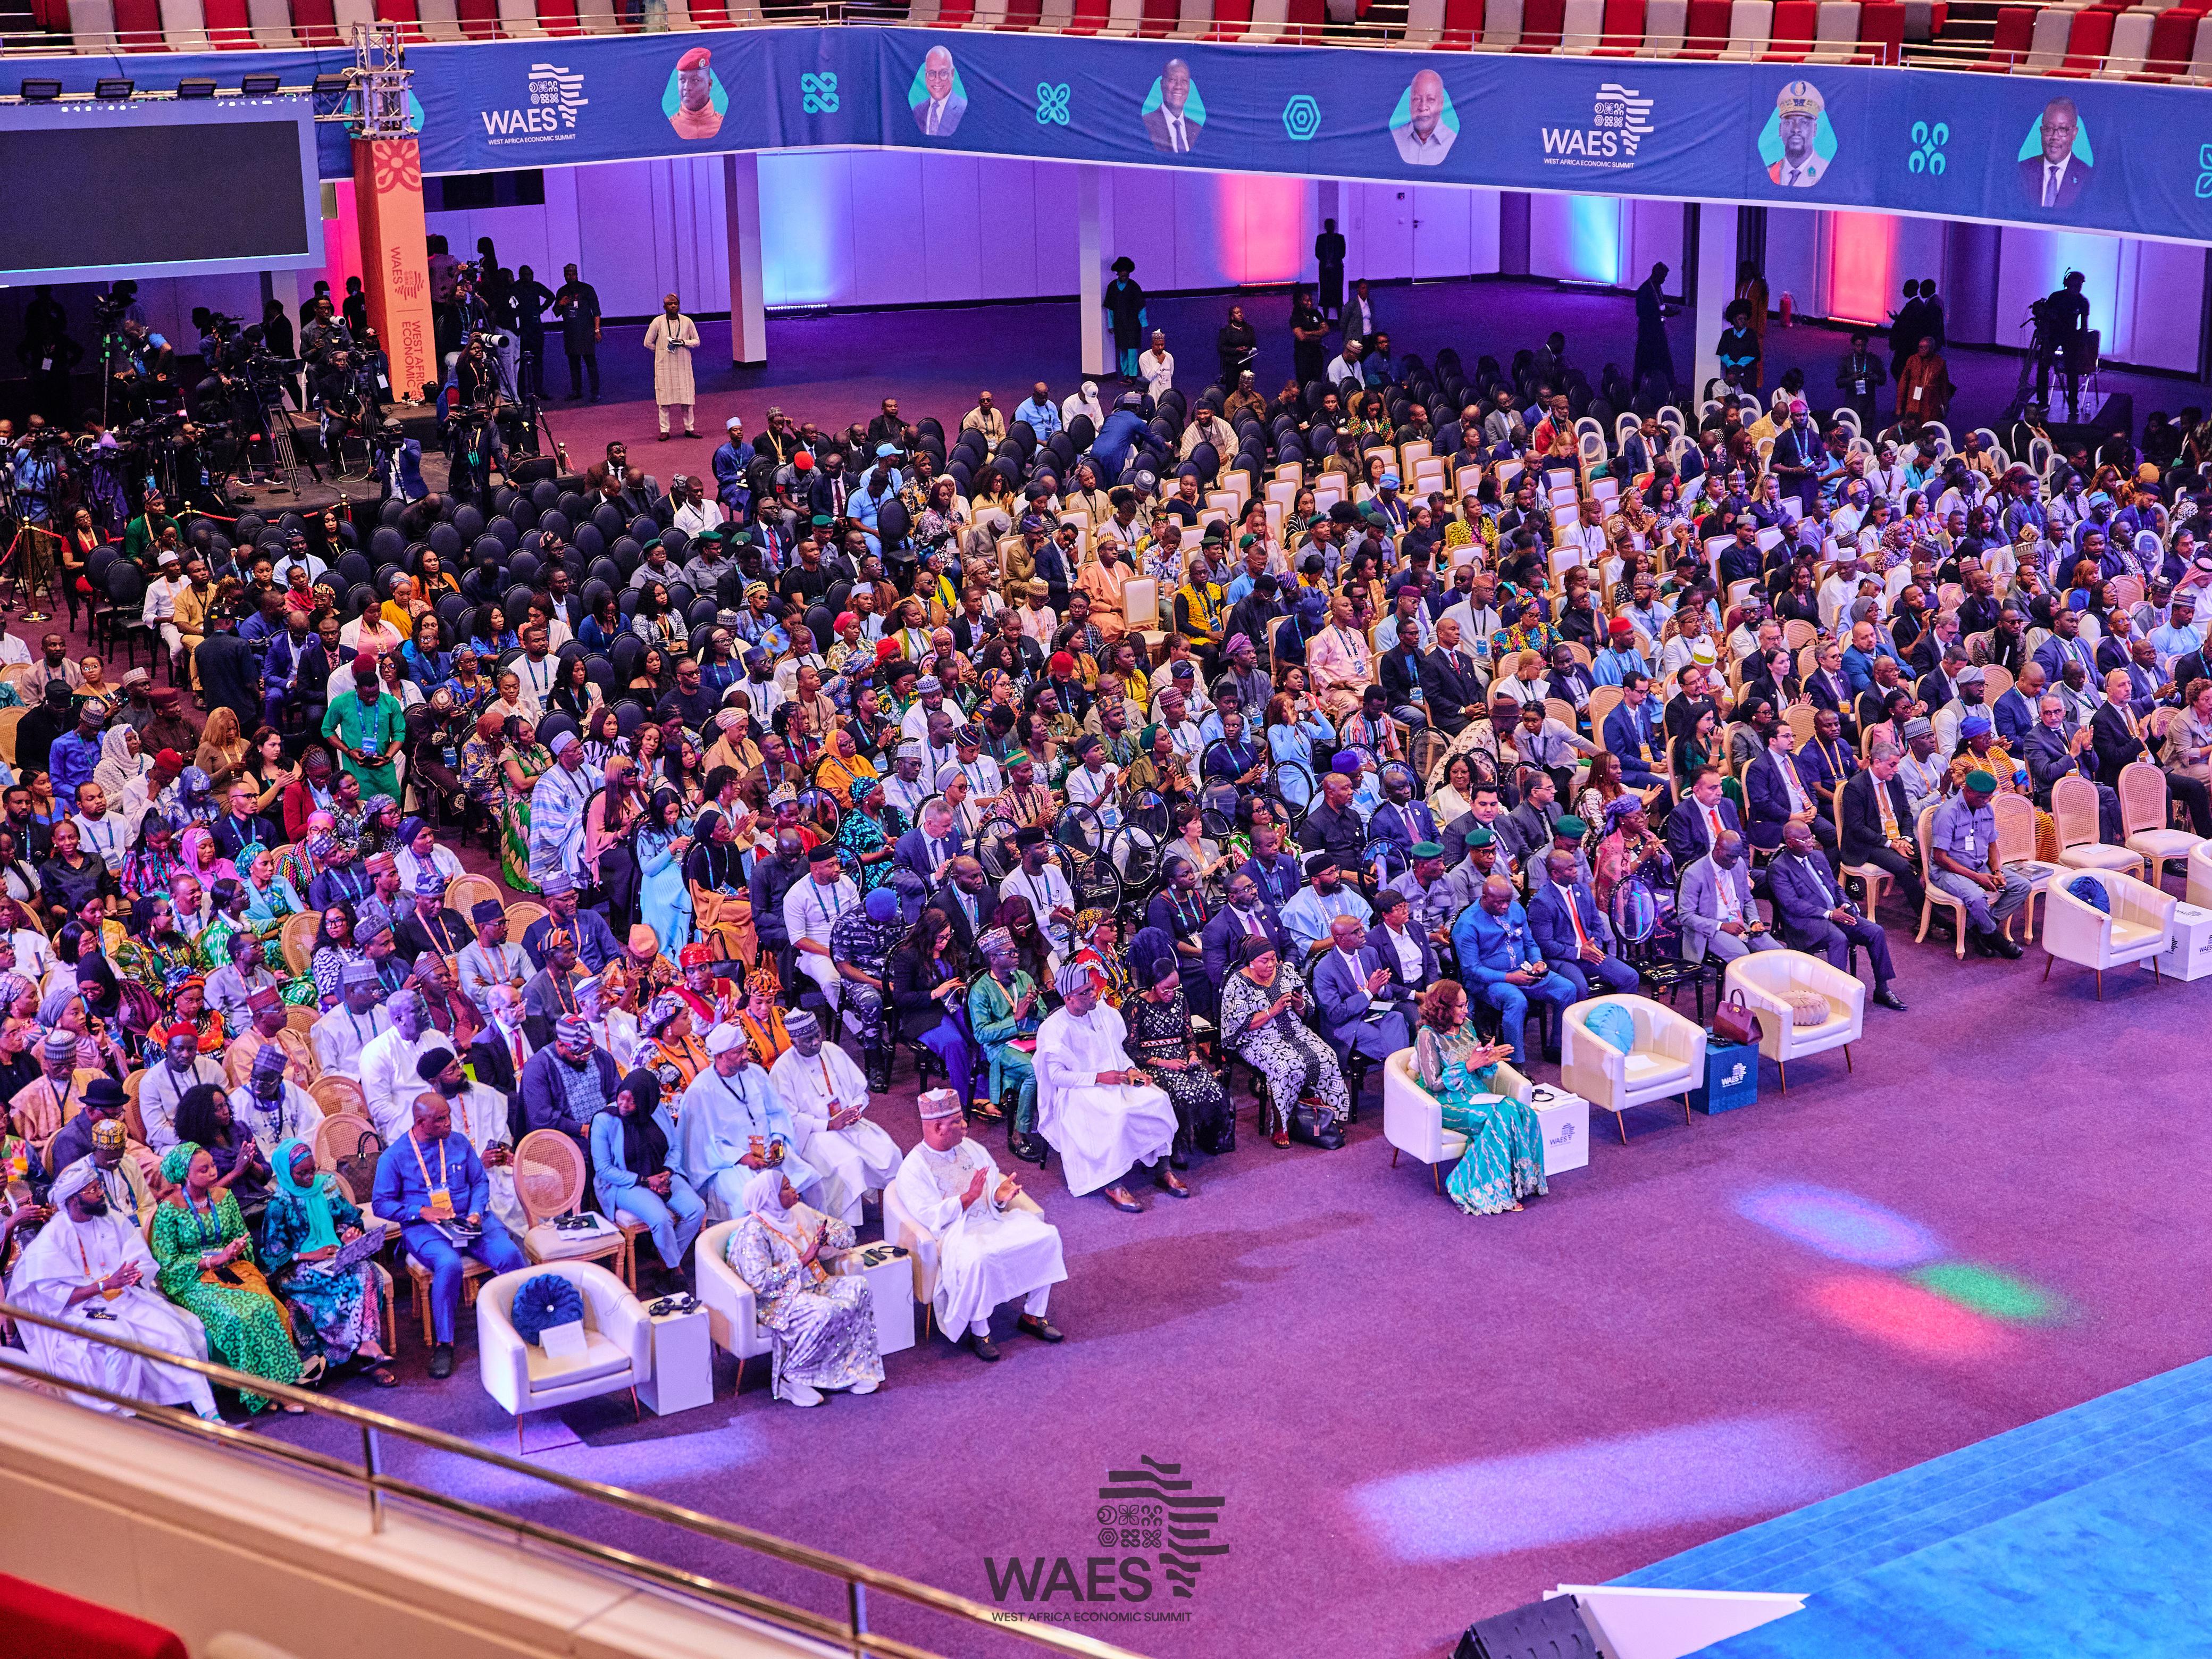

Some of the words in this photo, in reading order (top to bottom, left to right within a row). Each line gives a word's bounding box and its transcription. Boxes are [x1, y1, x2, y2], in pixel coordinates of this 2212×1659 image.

[481, 107, 558, 135] WAES
[1541, 128, 1618, 157] WAES
[390, 247, 403, 284] WAES
[412, 321, 423, 354] WEST
[402, 321, 416, 388] ECONOMIC
[1721, 1075, 1739, 1085] WAES
[1549, 1136, 1567, 1145] WAES
